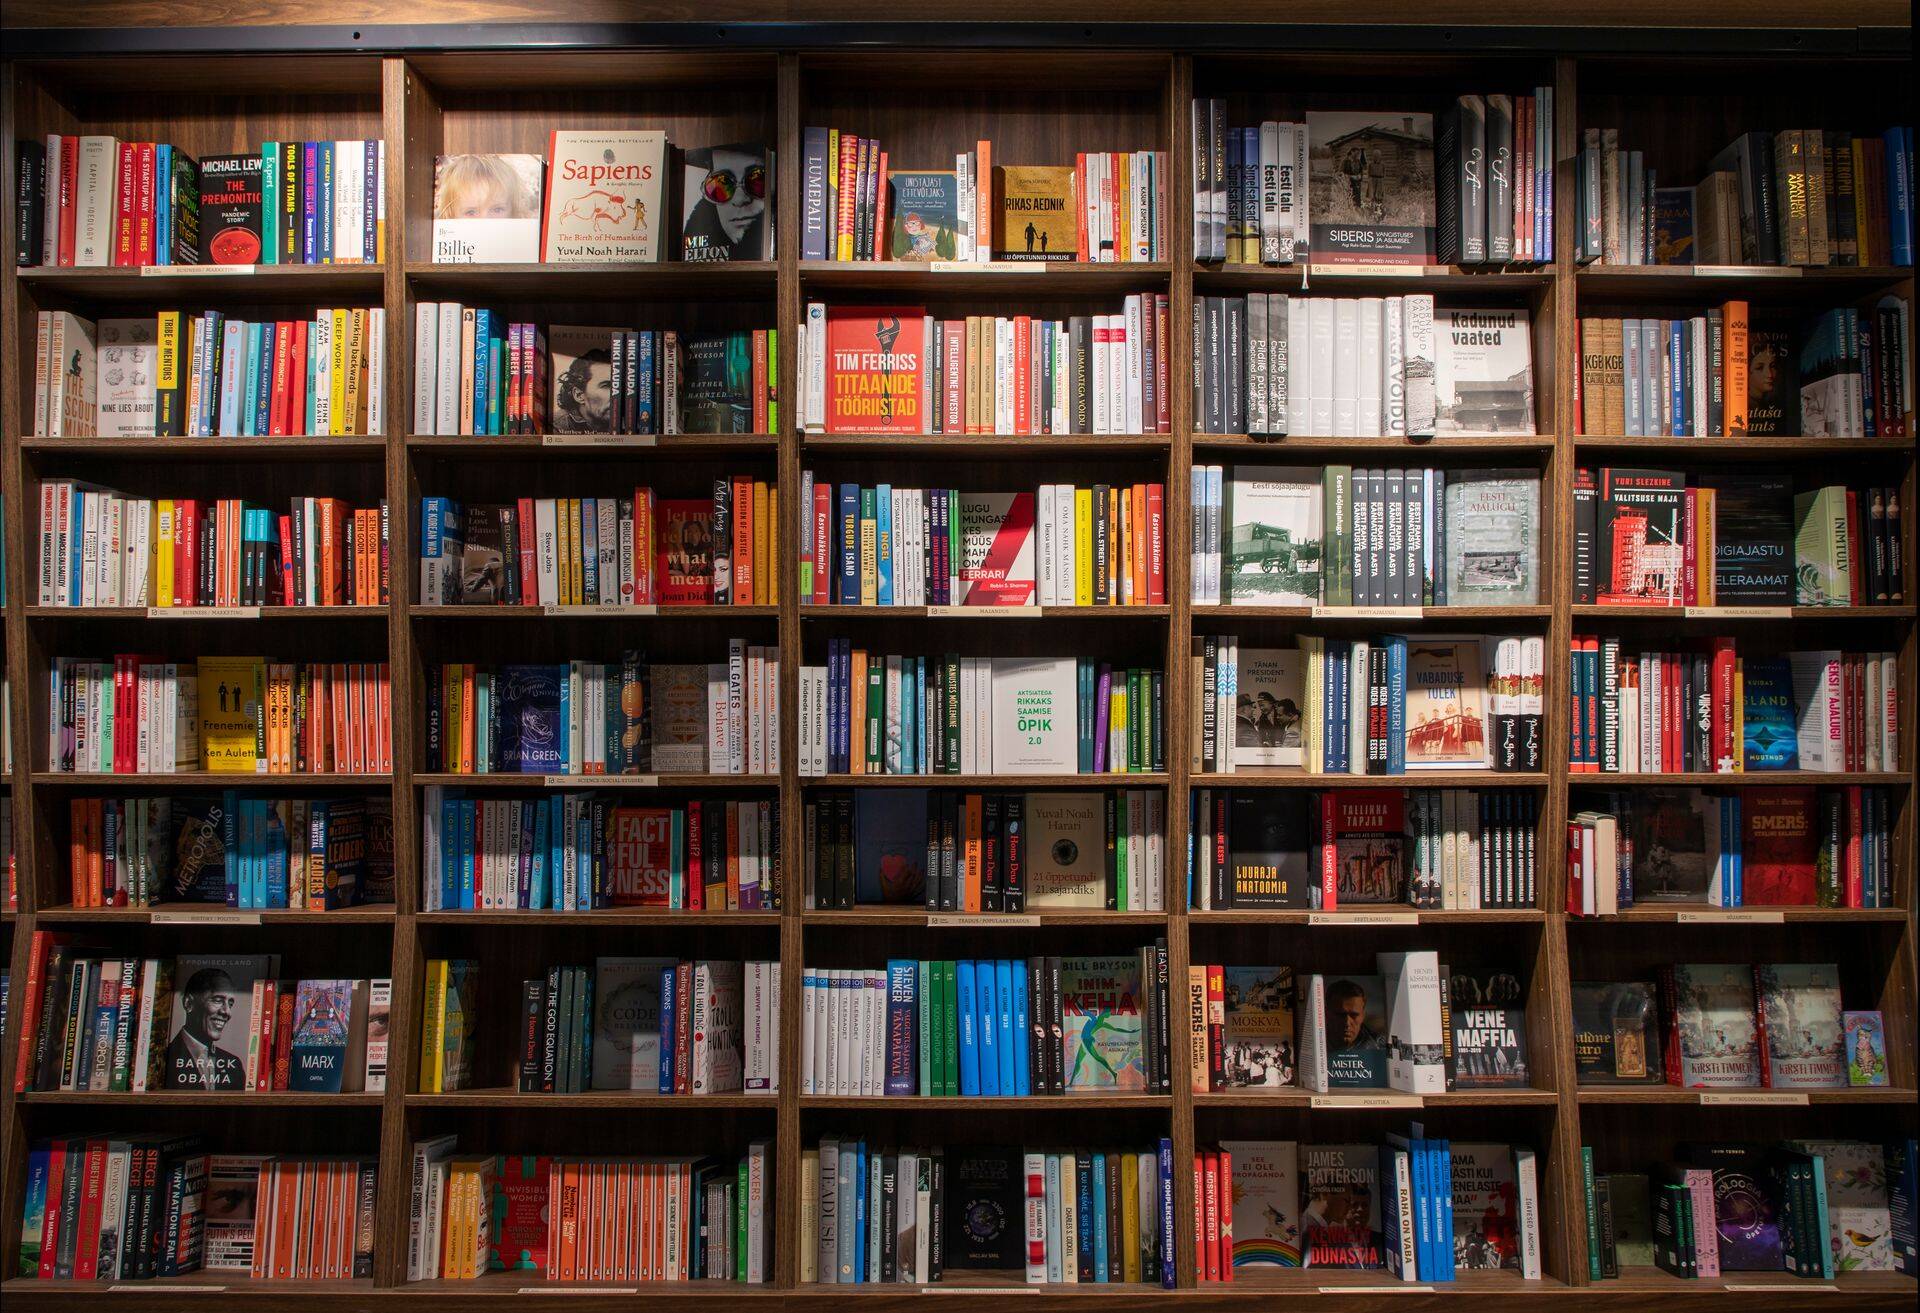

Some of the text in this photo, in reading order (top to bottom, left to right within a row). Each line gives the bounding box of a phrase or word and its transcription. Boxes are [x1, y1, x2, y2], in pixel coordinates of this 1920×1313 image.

[202, 160, 241, 172] MICHAEL
[264, 156, 274, 188] Expert
[563, 160, 652, 186] Sapiens
[287, 170, 294, 179] OF
[226, 181, 245, 191] THE
[1265, 165, 1277, 212] Eesti talu
[286, 181, 294, 212] TITANS
[808, 157, 822, 233] LUMEPALL
[1006, 198, 1064, 210] RIKAS AEDNIK
[1330, 230, 1373, 242] SIBERIS
[438, 242, 475, 255] Billie
[558, 247, 647, 256] Yuval Noah Harari
[1452, 312, 1515, 329] Kadunud
[165, 319, 173, 340] TRIBE
[1453, 331, 1500, 346] vaated
[475, 313, 487, 399] NALA'S WORLD
[835, 354, 915, 370] TIM FERRISS
[1585, 355, 1604, 369] KGB
[1605, 354, 1624, 369] KGB
[163, 351, 172, 381] MENTORS
[612, 339, 621, 395] NIKI LAUDA
[835, 375, 916, 394] TITAANIDE
[102, 403, 153, 413] NINE LIES ABOUT
[835, 396, 916, 416] TÖÖRIISTAD
[949, 390, 957, 424] INVESTOR
[1636, 478, 1671, 486] SLEZKINE
[1615, 494, 1678, 502] VALITSUSE MAJA
[962, 504, 989, 513] LUGU
[963, 526, 981, 535] KES
[846, 514, 854, 576] TURGUDE ISAND
[963, 535, 991, 546] MÜÜS
[1835, 517, 1848, 572] INIMTULV
[622, 521, 631, 582] BRUCE DICKINSON
[963, 548, 993, 556] MAHA
[963, 559, 986, 568] OMA
[962, 570, 1004, 579] FERRARI
[730, 646, 740, 709] BILL GATES
[1417, 673, 1464, 683] VABADUSE
[1828, 659, 1839, 686] SEKSI
[1428, 688, 1456, 699] TULEK
[716, 702, 727, 746] Behave
[1018, 717, 1052, 731] ÕPIK
[1602, 697, 1618, 771] pihtimused
[204, 748, 223, 757] Ken
[504, 750, 528, 760] BRIAN
[1035, 808, 1093, 820] Yuval Noah
[620, 818, 668, 842] FACT
[1048, 821, 1081, 831] Harari
[176, 806, 222, 895] METROPOLIS
[618, 844, 654, 867] FUL
[1236, 866, 1278, 879] LUURAJA
[617, 870, 668, 894] NESS
[1236, 881, 1287, 893] ANATOOMIA
[1048, 885, 1094, 896] sajandiks
[1063, 961, 1135, 971] BILL BRYSON
[124, 963, 132, 988] DOOM
[893, 968, 902, 1002] PINKER
[904, 967, 913, 1002] STEVEN
[1064, 993, 1137, 1017] KEHA
[1464, 1010, 1504, 1028] VENE
[115, 991, 131, 1071] NIALL FERGUSON
[544, 991, 557, 1080] THE GOD EQUATION
[1457, 1029, 1517, 1047] MAFFIA
[96, 1013, 109, 1079] METROPOLIS
[176, 1058, 236, 1069] BARACK
[302, 1055, 333, 1069] MARX
[1332, 1059, 1364, 1070] MISTER
[178, 1073, 231, 1084] OBAMA
[1308, 1152, 1344, 1167] JAMES
[752, 1152, 761, 1201] VAXXERS
[1309, 1168, 1374, 1183] PATTERSON
[166, 1167, 182, 1261] WHY NATIONS FAIL
[1400, 1189, 1412, 1263] RAHA ON VABA
[1310, 1245, 1378, 1264] DÜNASTIA
